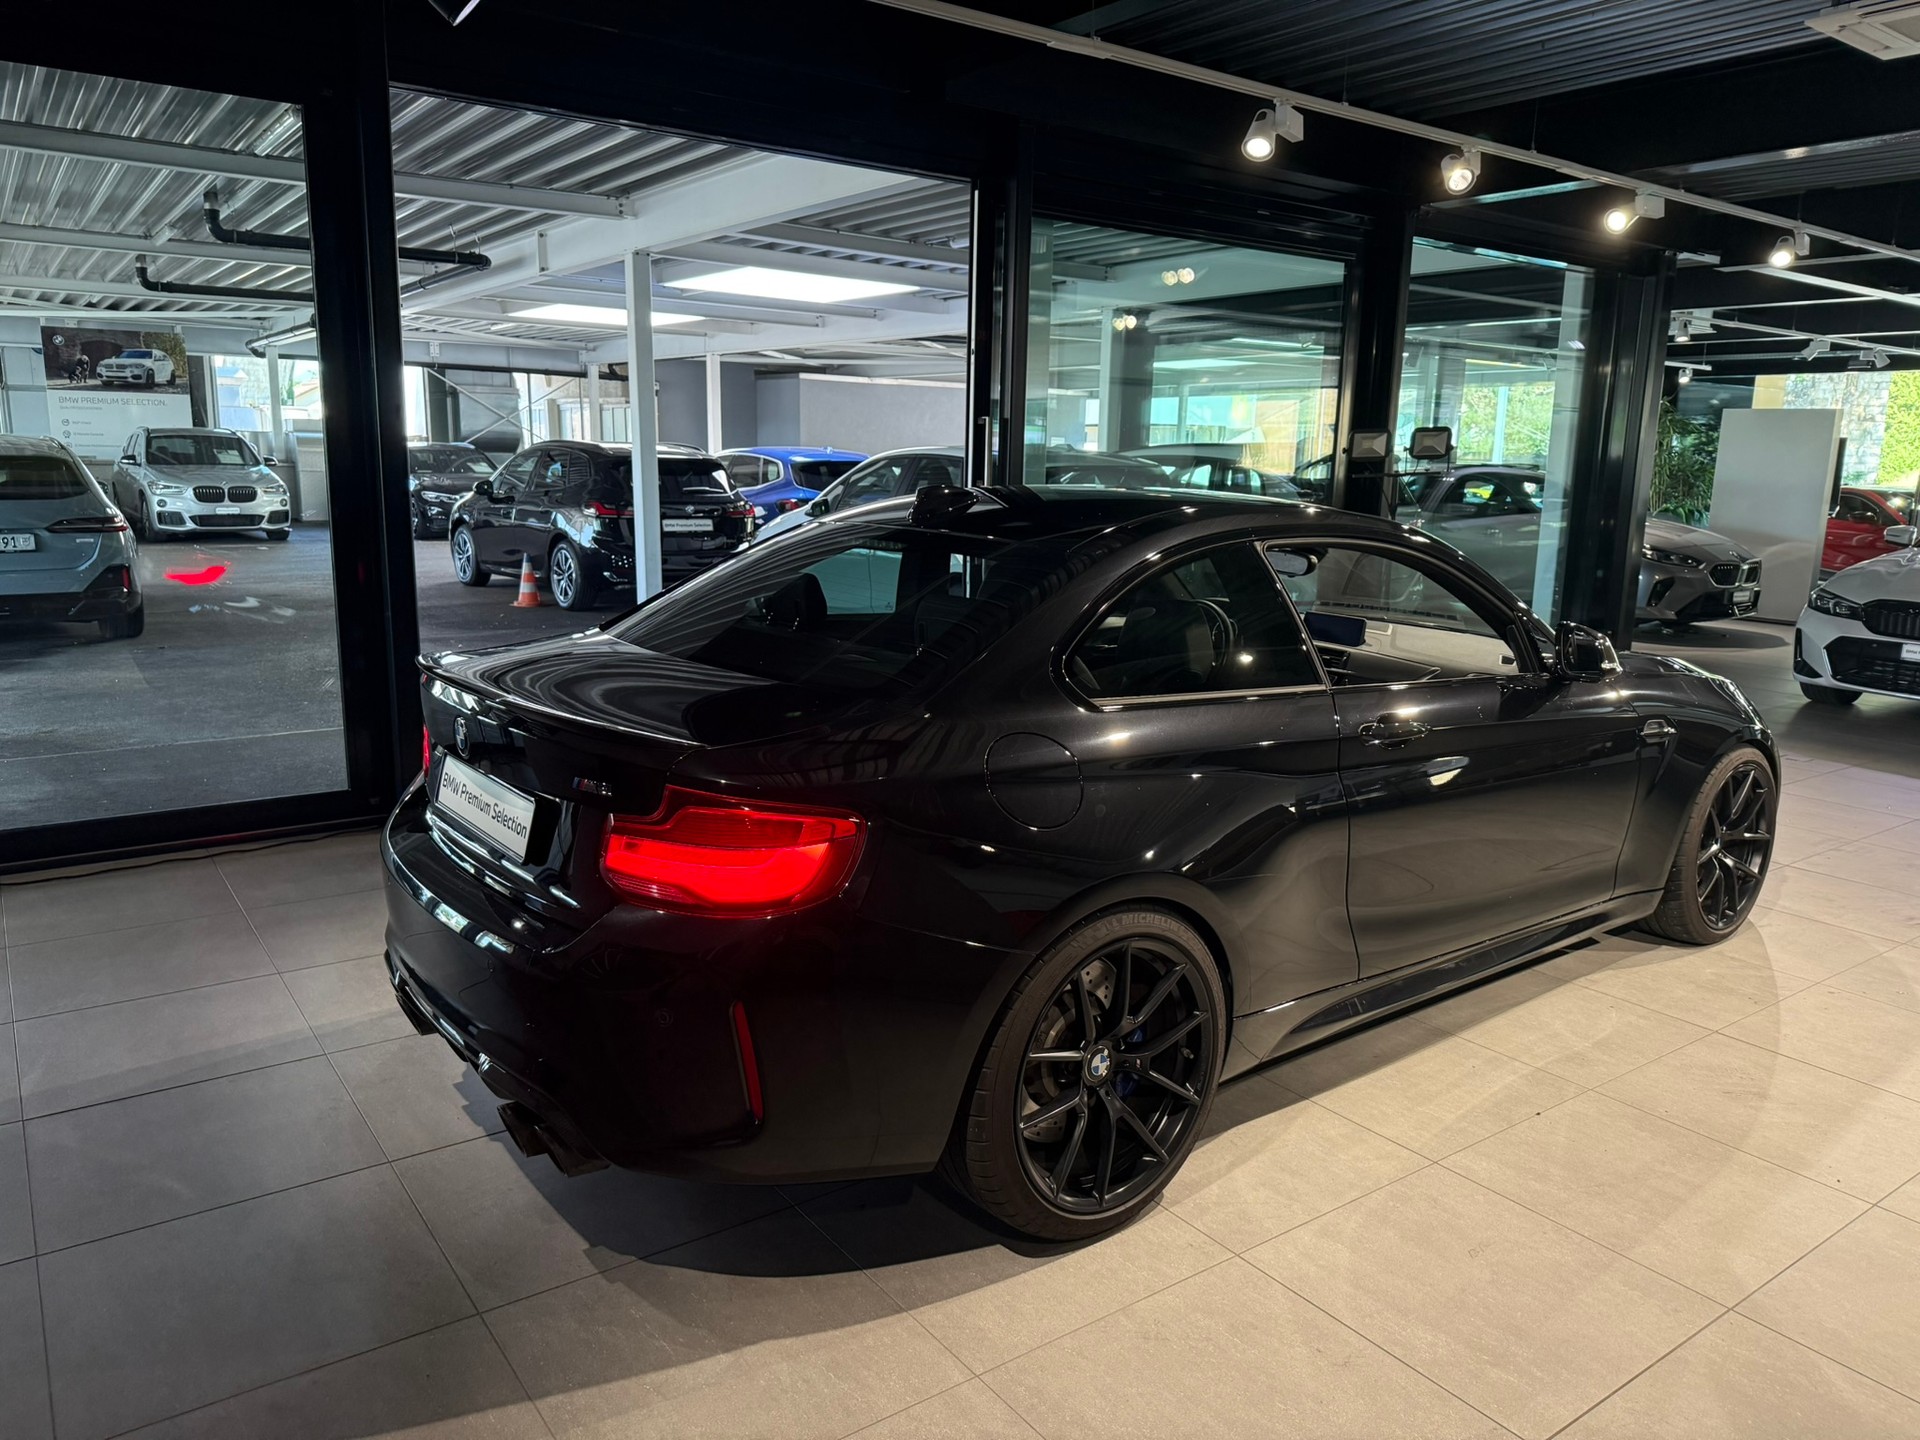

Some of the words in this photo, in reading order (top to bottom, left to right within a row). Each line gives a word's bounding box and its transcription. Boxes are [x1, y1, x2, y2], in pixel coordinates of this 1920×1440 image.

[58, 395, 79, 404] BMW
[80, 396, 119, 405] PREMIUM
[120, 398, 168, 407] SELECTION.
[442, 772, 462, 796] BMW
[459, 783, 492, 817] Premium
[490, 802, 528, 840] Selection
[1121, 912, 1180, 932] MICHELIN
